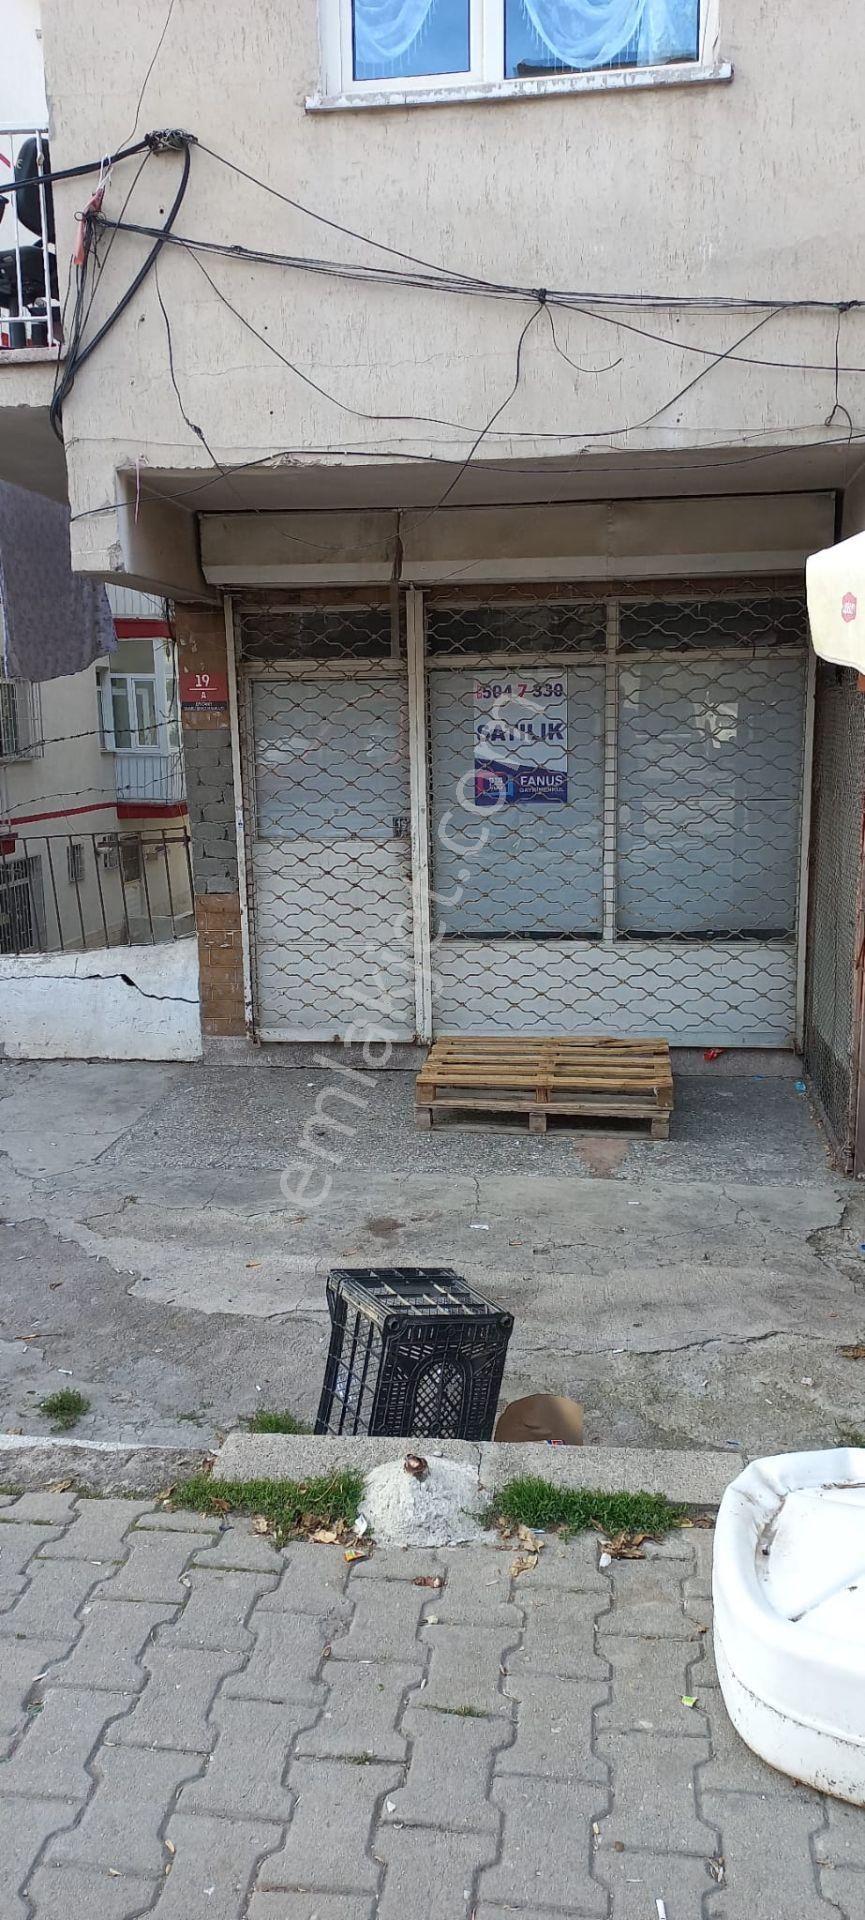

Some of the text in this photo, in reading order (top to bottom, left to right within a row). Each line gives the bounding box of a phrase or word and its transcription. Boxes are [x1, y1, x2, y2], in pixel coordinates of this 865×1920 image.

[195, 674, 210, 687] 19
[201, 691, 207, 699] A
[517, 683, 528, 697] 7
[520, 776, 563, 787] FANUS
